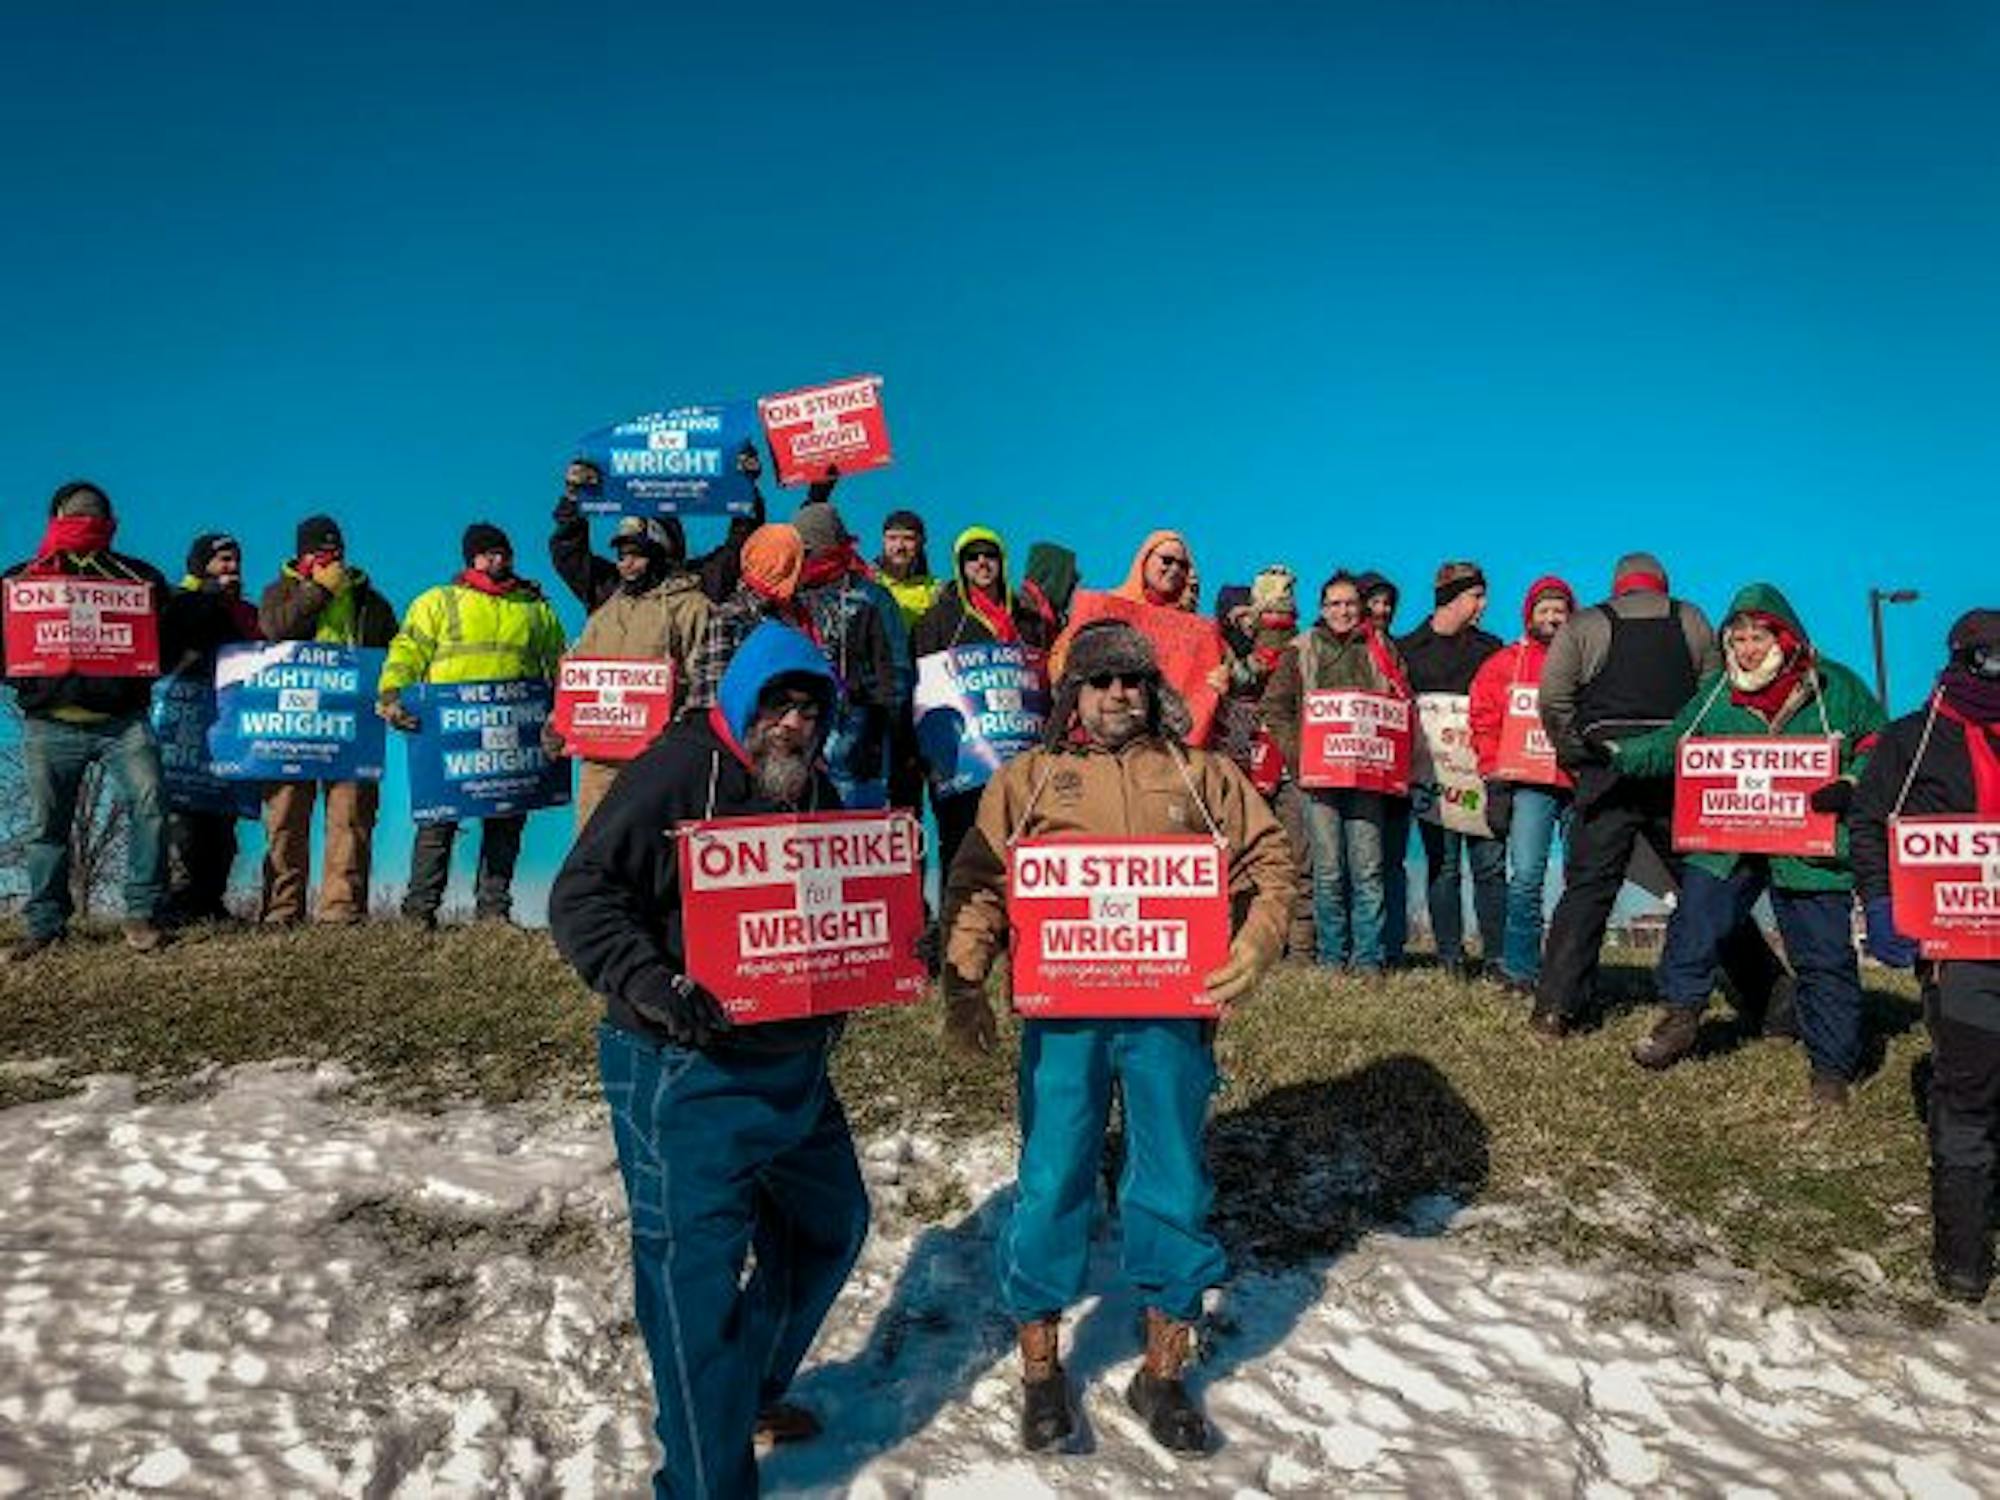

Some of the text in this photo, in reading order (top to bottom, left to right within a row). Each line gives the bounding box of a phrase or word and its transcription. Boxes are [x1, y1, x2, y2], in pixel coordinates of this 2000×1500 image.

[768, 385, 872, 421] ON STRIKE
[611, 450, 719, 475] WRIGHT
[15, 586, 145, 607] ON STRIKE
[41, 626, 128, 641] WRIGHT
[299, 647, 340, 667] ARE
[565, 668, 665, 687] ON STRIKE
[458, 684, 492, 702] WE
[443, 702, 547, 730] FIGHTING
[1311, 700, 1342, 718] ON
[241, 712, 354, 737] WRIGHT
[443, 748, 545, 777] WRIGHT
[1686, 749, 1828, 771] ON STRIKE
[1744, 777, 1766, 790] for
[1706, 792, 1801, 813] WRIGHT
[700, 832, 907, 877] ON STRIKE
[1904, 832, 1959, 856] ON
[1020, 855, 1215, 889] ON STRIKE
[806, 881, 832, 904] for
[1940, 885, 2000, 908] WRI
[1099, 895, 1132, 918] for
[745, 907, 883, 948] WRIGHT
[1046, 925, 1184, 953] WRIGHT
